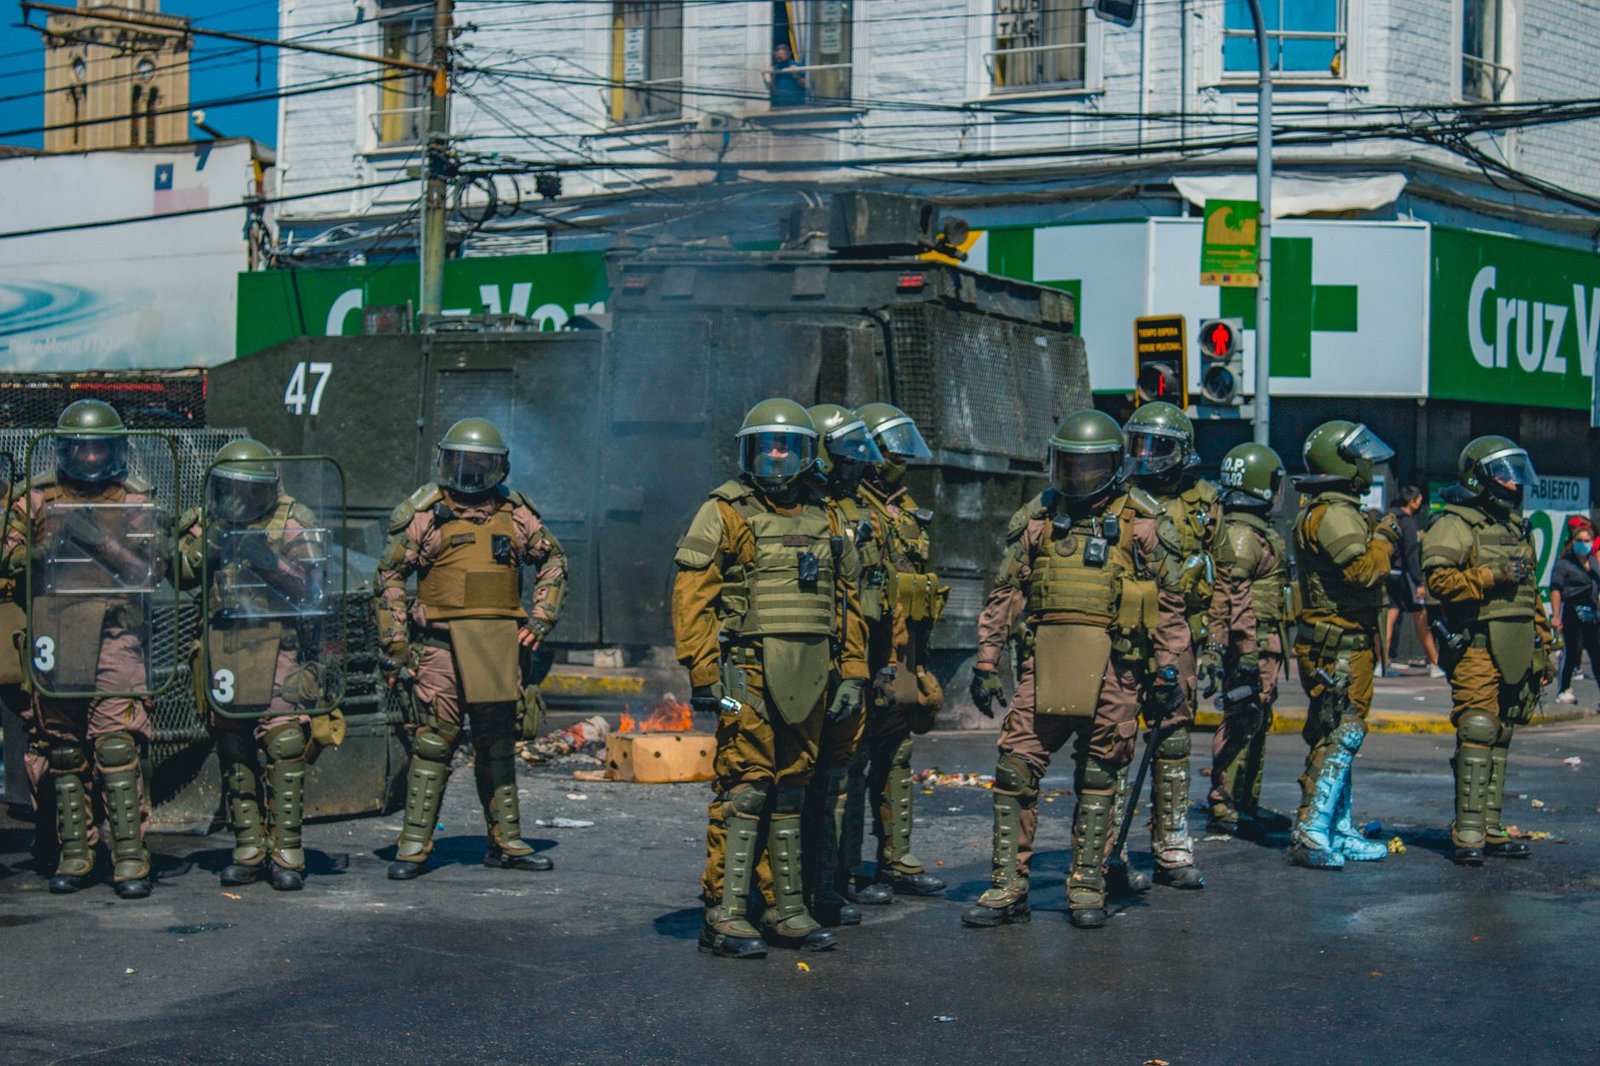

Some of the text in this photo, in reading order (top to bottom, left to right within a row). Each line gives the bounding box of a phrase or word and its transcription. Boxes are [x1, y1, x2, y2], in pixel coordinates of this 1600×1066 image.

[1468, 265, 1568, 374] Cruz
[284, 361, 333, 415] 47
[1531, 479, 1580, 501] ABIERTO
[34, 636, 55, 672] 3
[212, 668, 235, 704] 3
